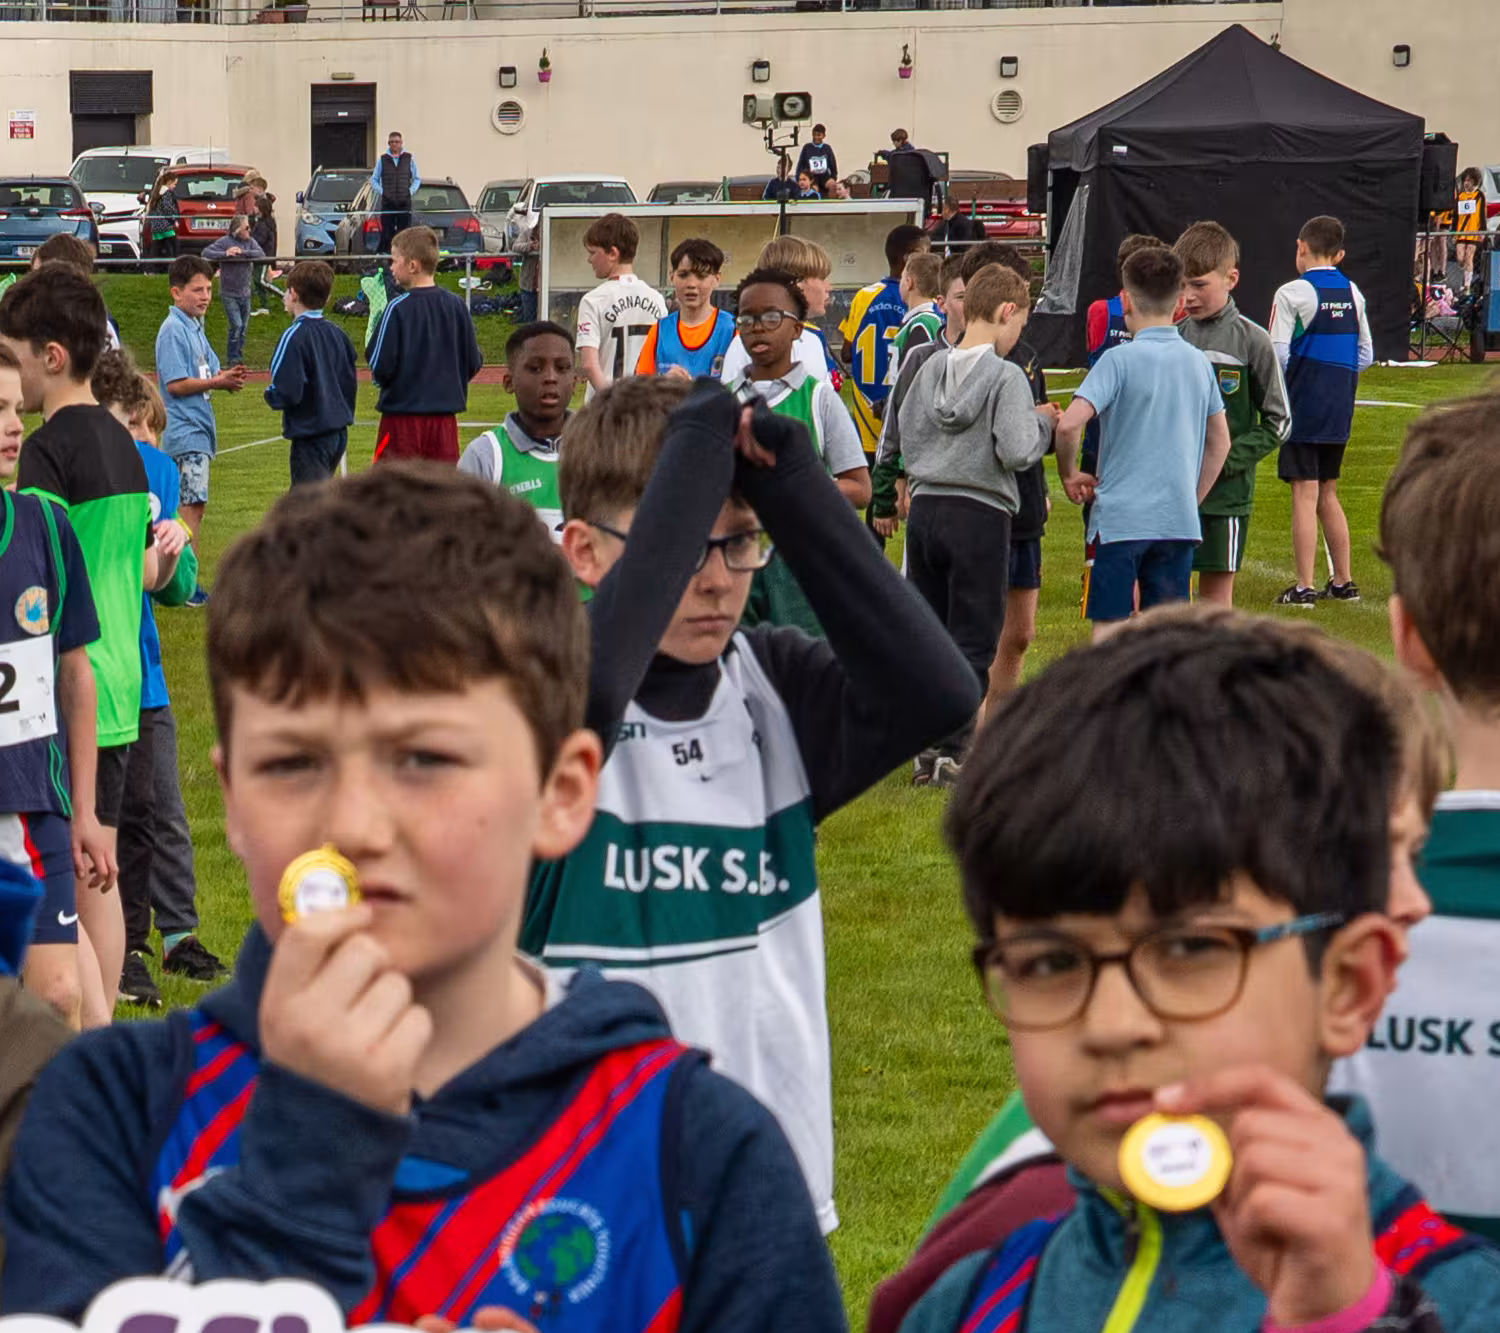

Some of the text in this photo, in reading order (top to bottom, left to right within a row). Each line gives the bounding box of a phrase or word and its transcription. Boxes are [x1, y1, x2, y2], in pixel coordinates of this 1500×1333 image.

[605, 295, 662, 324] GARNACHO
[672, 738, 704, 766] 54
[604, 842, 711, 893] LUSK
[1366, 1017, 1473, 1056] LUSK
